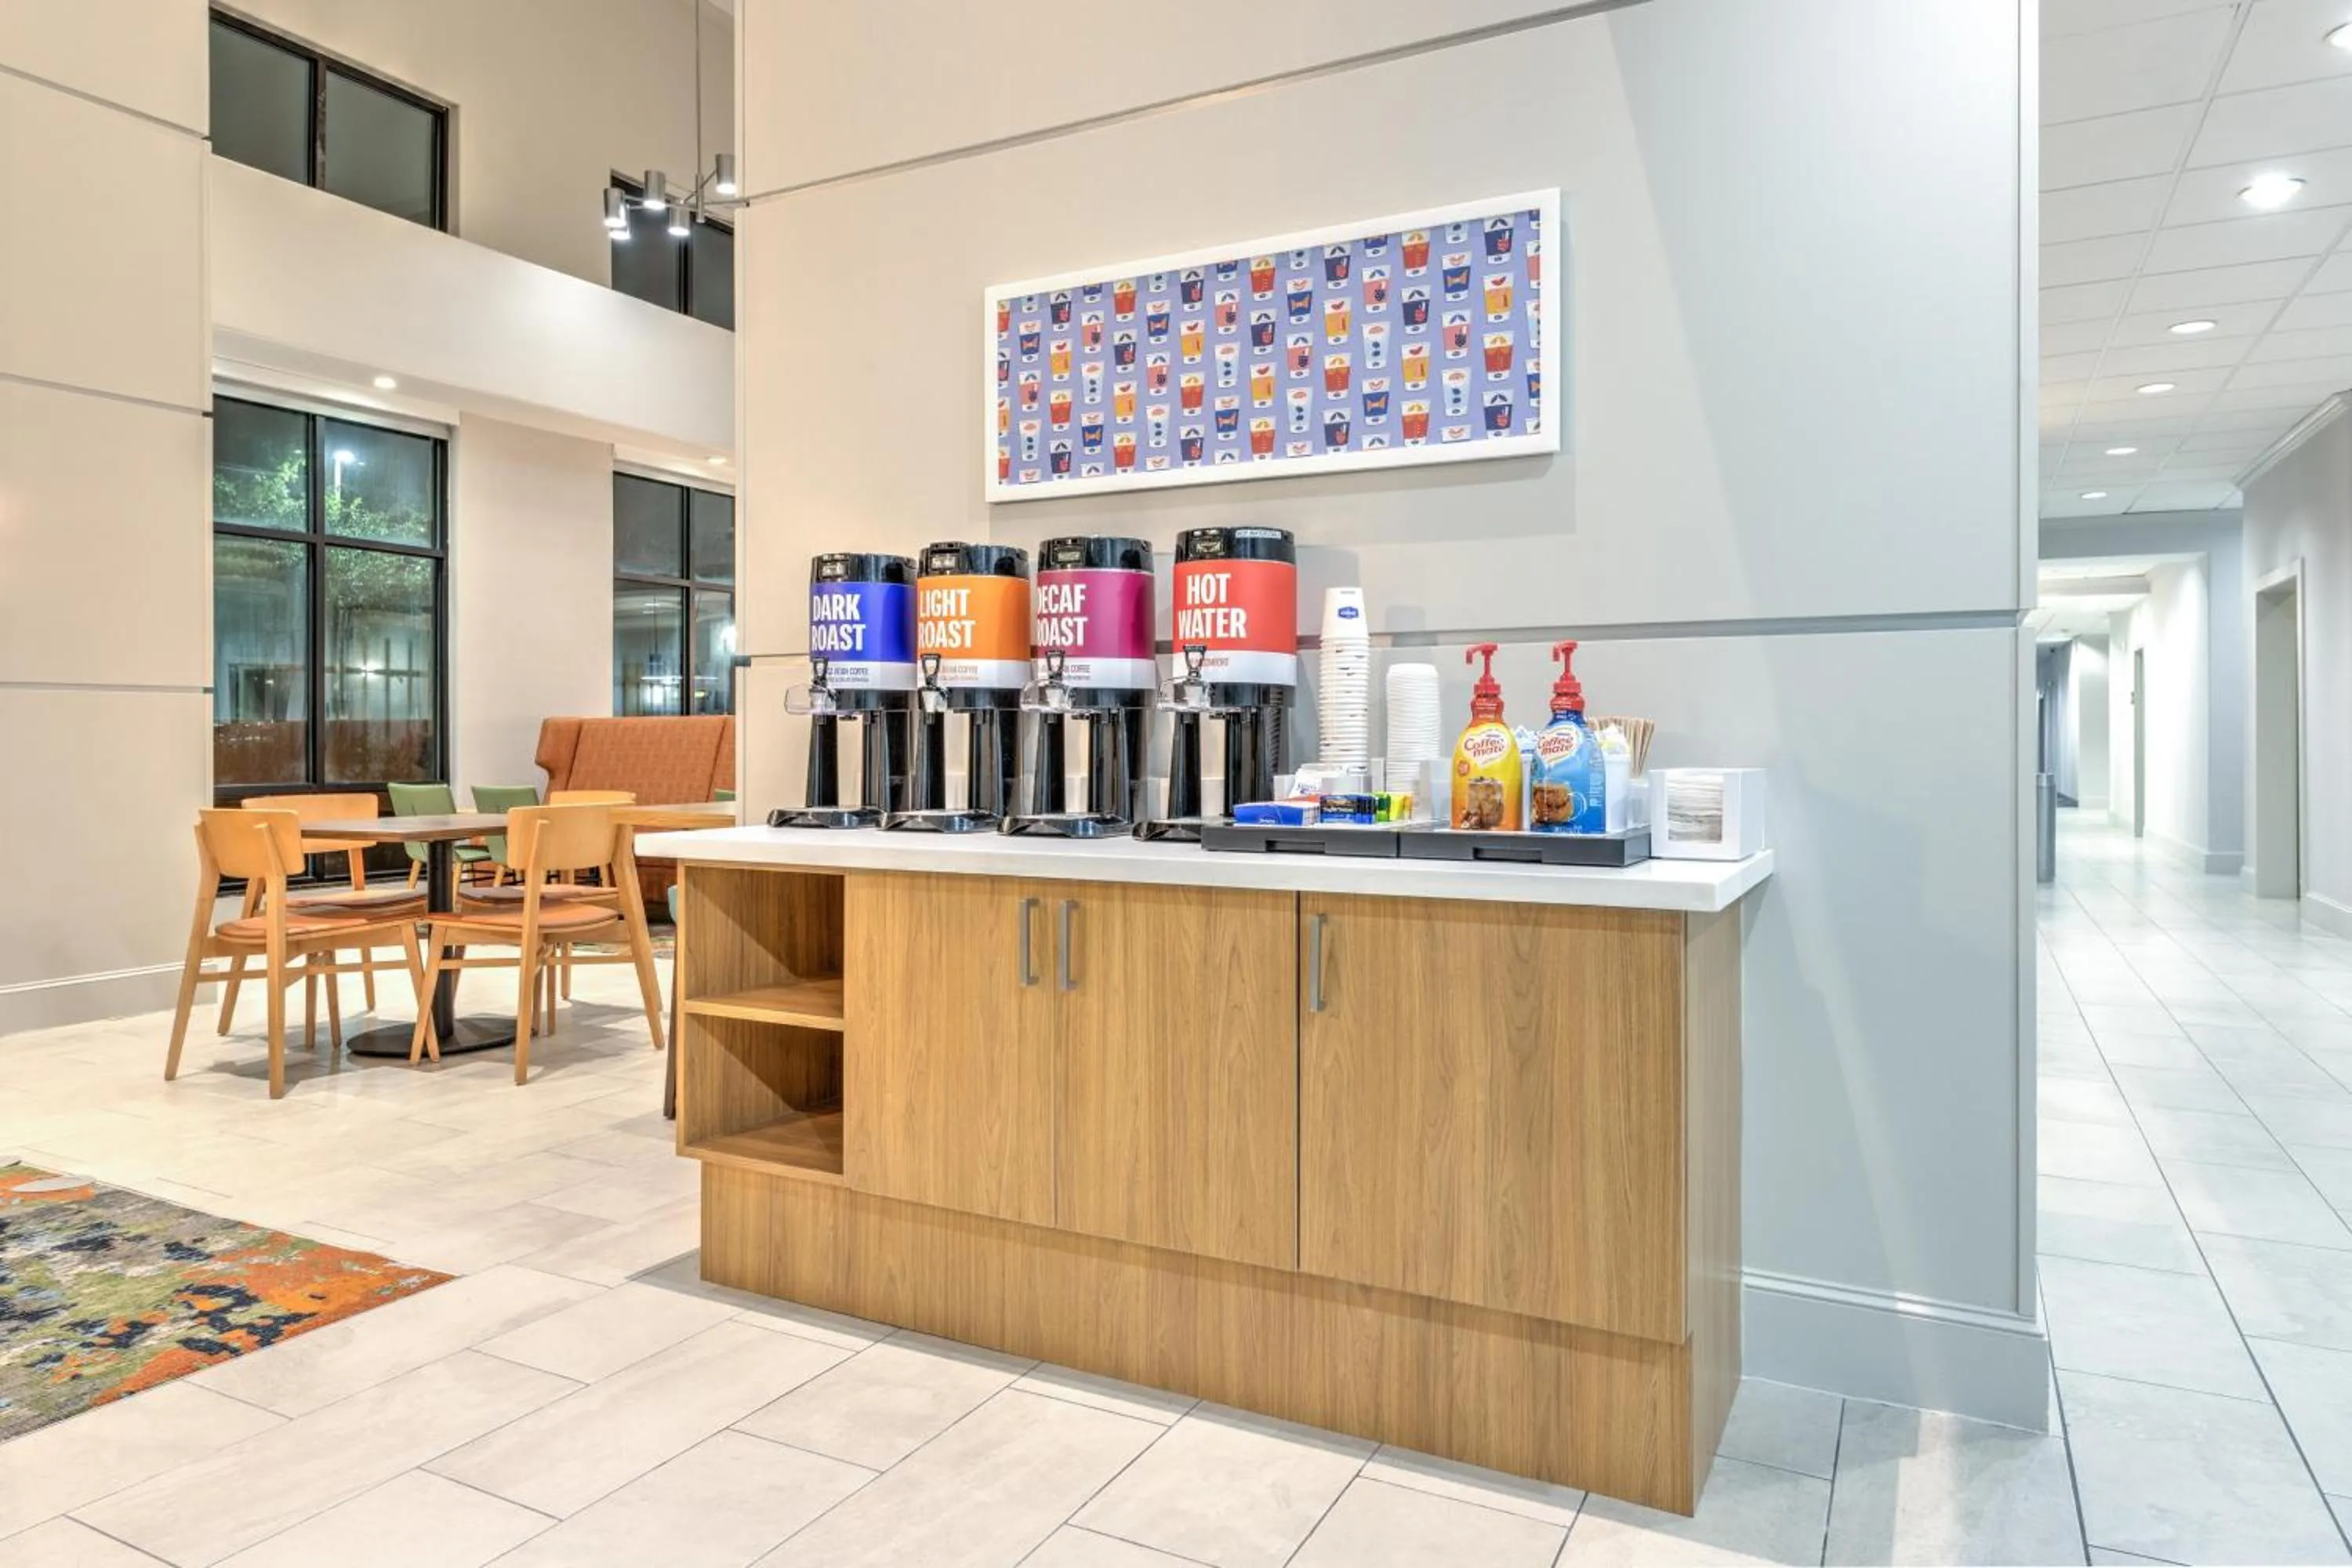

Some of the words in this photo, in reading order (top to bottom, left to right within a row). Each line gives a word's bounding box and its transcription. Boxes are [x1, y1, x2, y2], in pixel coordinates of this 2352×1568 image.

[1186, 572, 1231, 604] HOT
[813, 593, 861, 622] DARK
[919, 589, 971, 618] LIGHT
[811, 623, 866, 652] ROAST
[918, 619, 976, 649] ROAST
[1178, 607, 1247, 640] WATER
